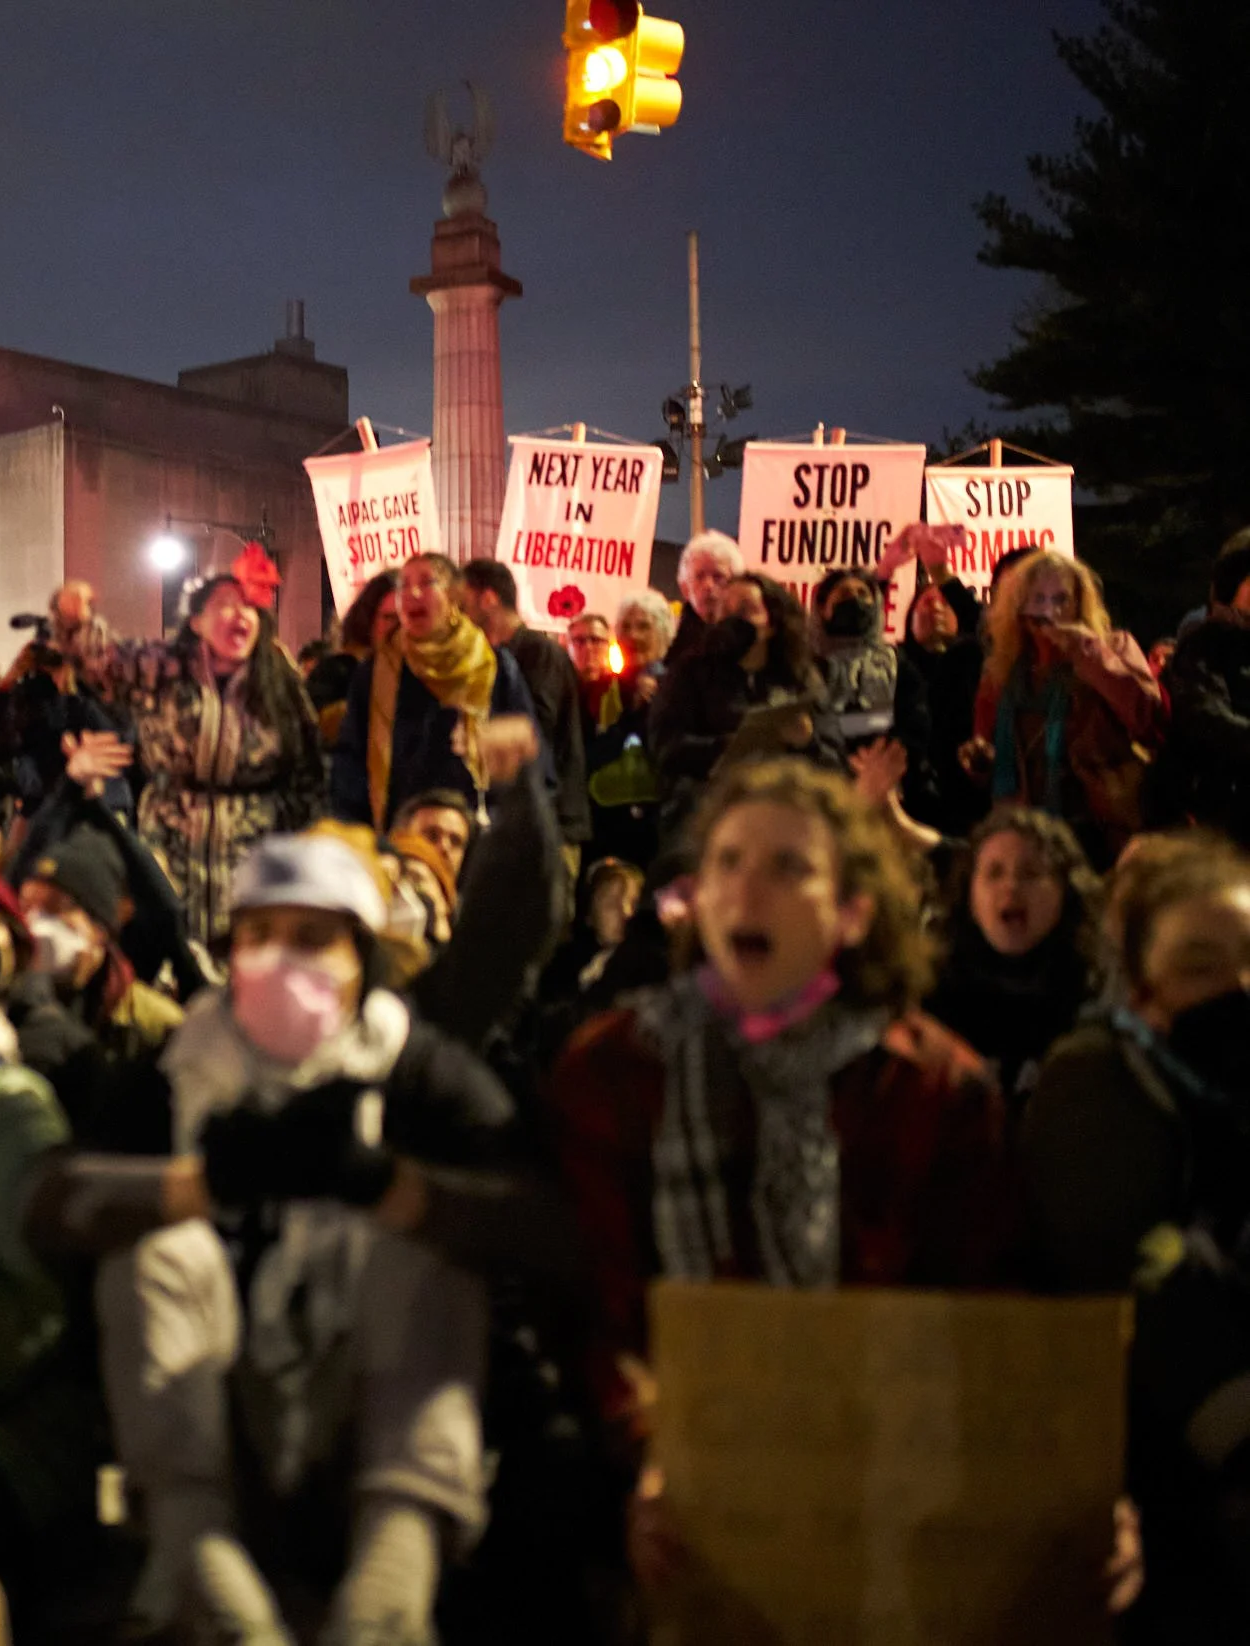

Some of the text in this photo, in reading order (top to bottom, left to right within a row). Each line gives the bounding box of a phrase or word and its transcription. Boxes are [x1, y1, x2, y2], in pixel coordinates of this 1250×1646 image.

[528, 451, 644, 494] NEXT YEAR
[793, 463, 870, 509] STOP
[338, 491, 420, 528] AIPAC GAVE
[565, 501, 593, 524] IN
[966, 480, 1031, 517] STOP
[347, 526, 420, 568] $101,570
[511, 530, 635, 578] LIBERATION
[761, 520, 892, 565] FUNDING
